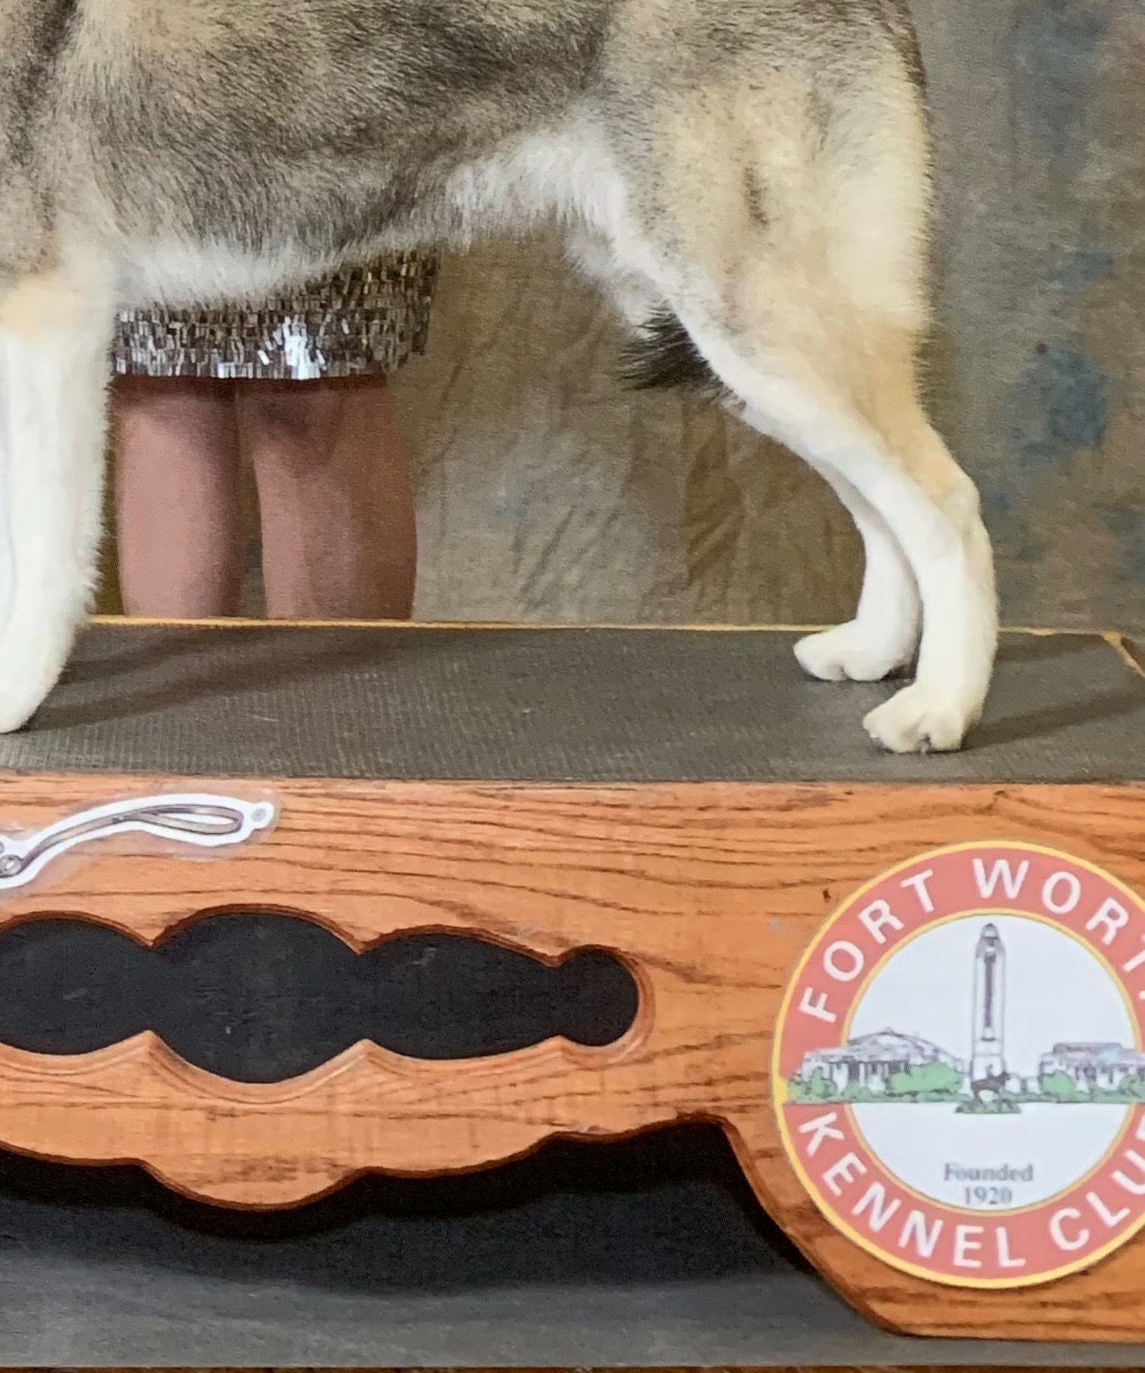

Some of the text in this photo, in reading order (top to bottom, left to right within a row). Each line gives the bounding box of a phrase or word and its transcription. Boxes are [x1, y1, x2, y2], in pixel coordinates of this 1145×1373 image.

[798, 858, 1145, 1024] FORT WOR
[799, 1112, 1145, 1268] KENNEL CLU
[943, 1163, 1033, 1181] Founded
[965, 1186, 1012, 1205] 1920
